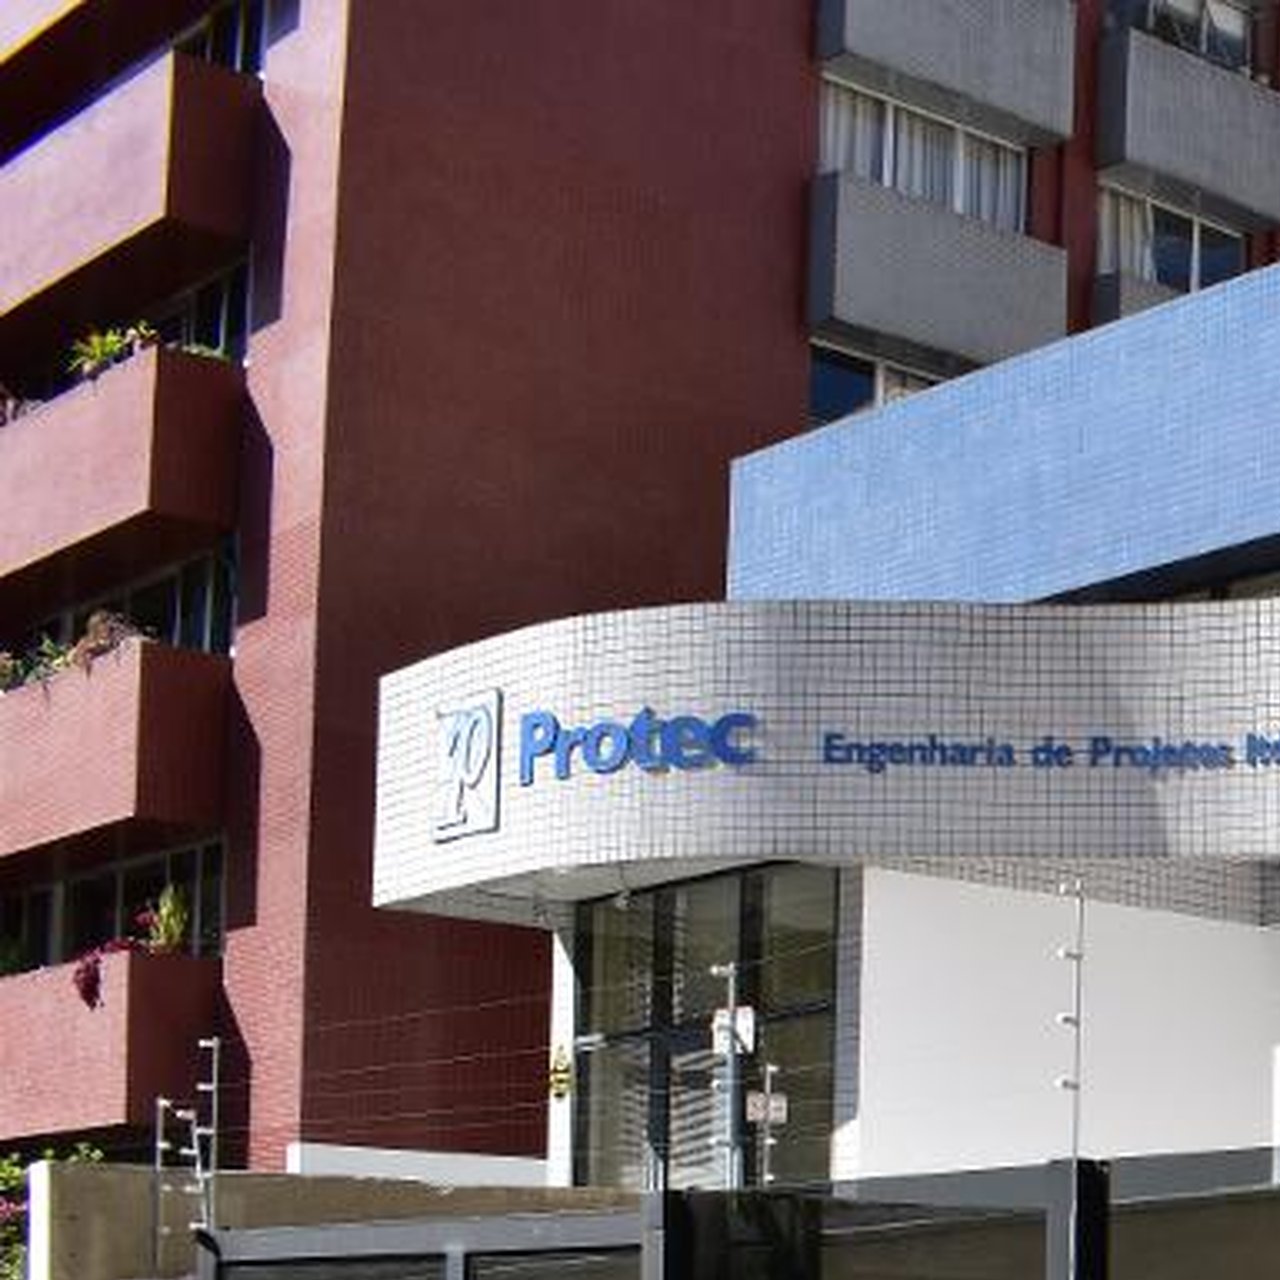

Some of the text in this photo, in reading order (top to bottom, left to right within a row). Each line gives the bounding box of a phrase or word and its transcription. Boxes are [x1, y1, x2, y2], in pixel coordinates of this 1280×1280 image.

[519, 705, 757, 787] Protec
[823, 732, 1017, 774] Engenharia
[1033, 735, 1074, 768] de
